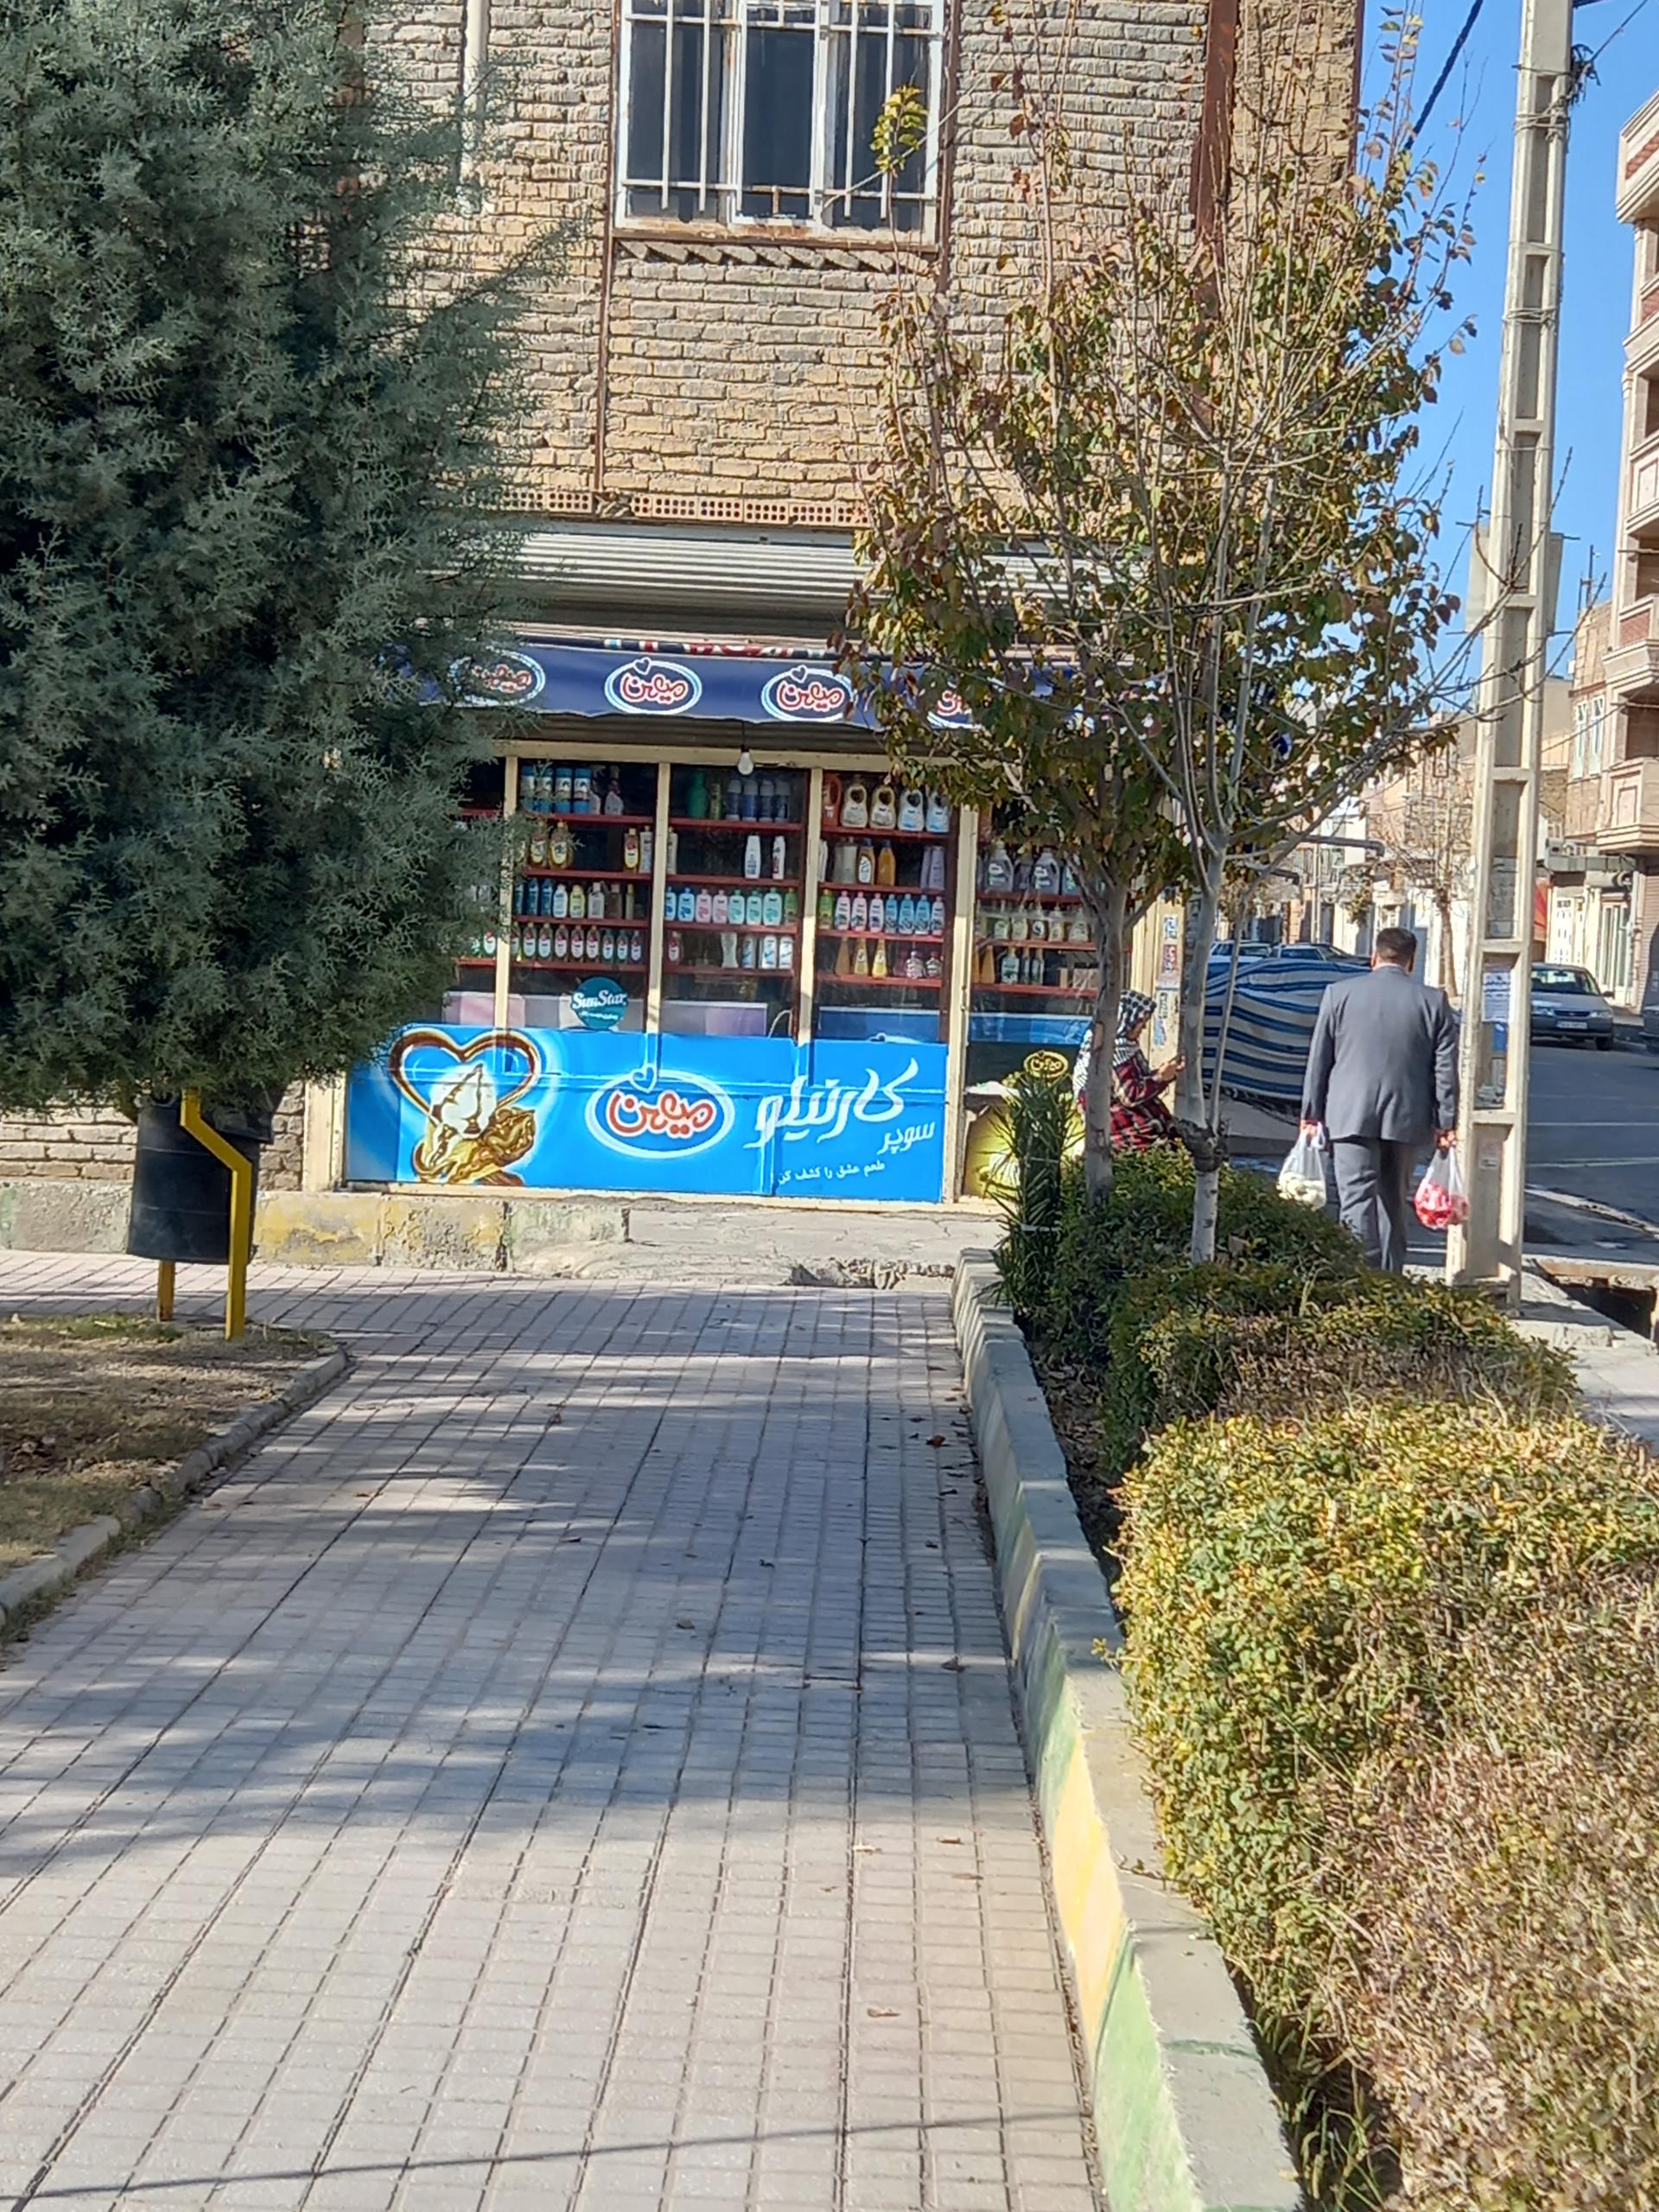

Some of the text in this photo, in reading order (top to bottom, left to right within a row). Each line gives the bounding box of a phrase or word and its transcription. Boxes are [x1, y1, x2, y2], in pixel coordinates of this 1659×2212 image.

[620, 671, 688, 705] میهن
[776, 679, 845, 713] میهن
[571, 989, 628, 1010] SunStar
[605, 1089, 718, 1140] میهن
[875, 1121, 936, 1155] سوپر
[794, 1166, 821, 1181] کشف
[823, 1166, 833, 1179] را
[836, 1163, 860, 1179] عشق
[863, 1159, 886, 1177] طعم
